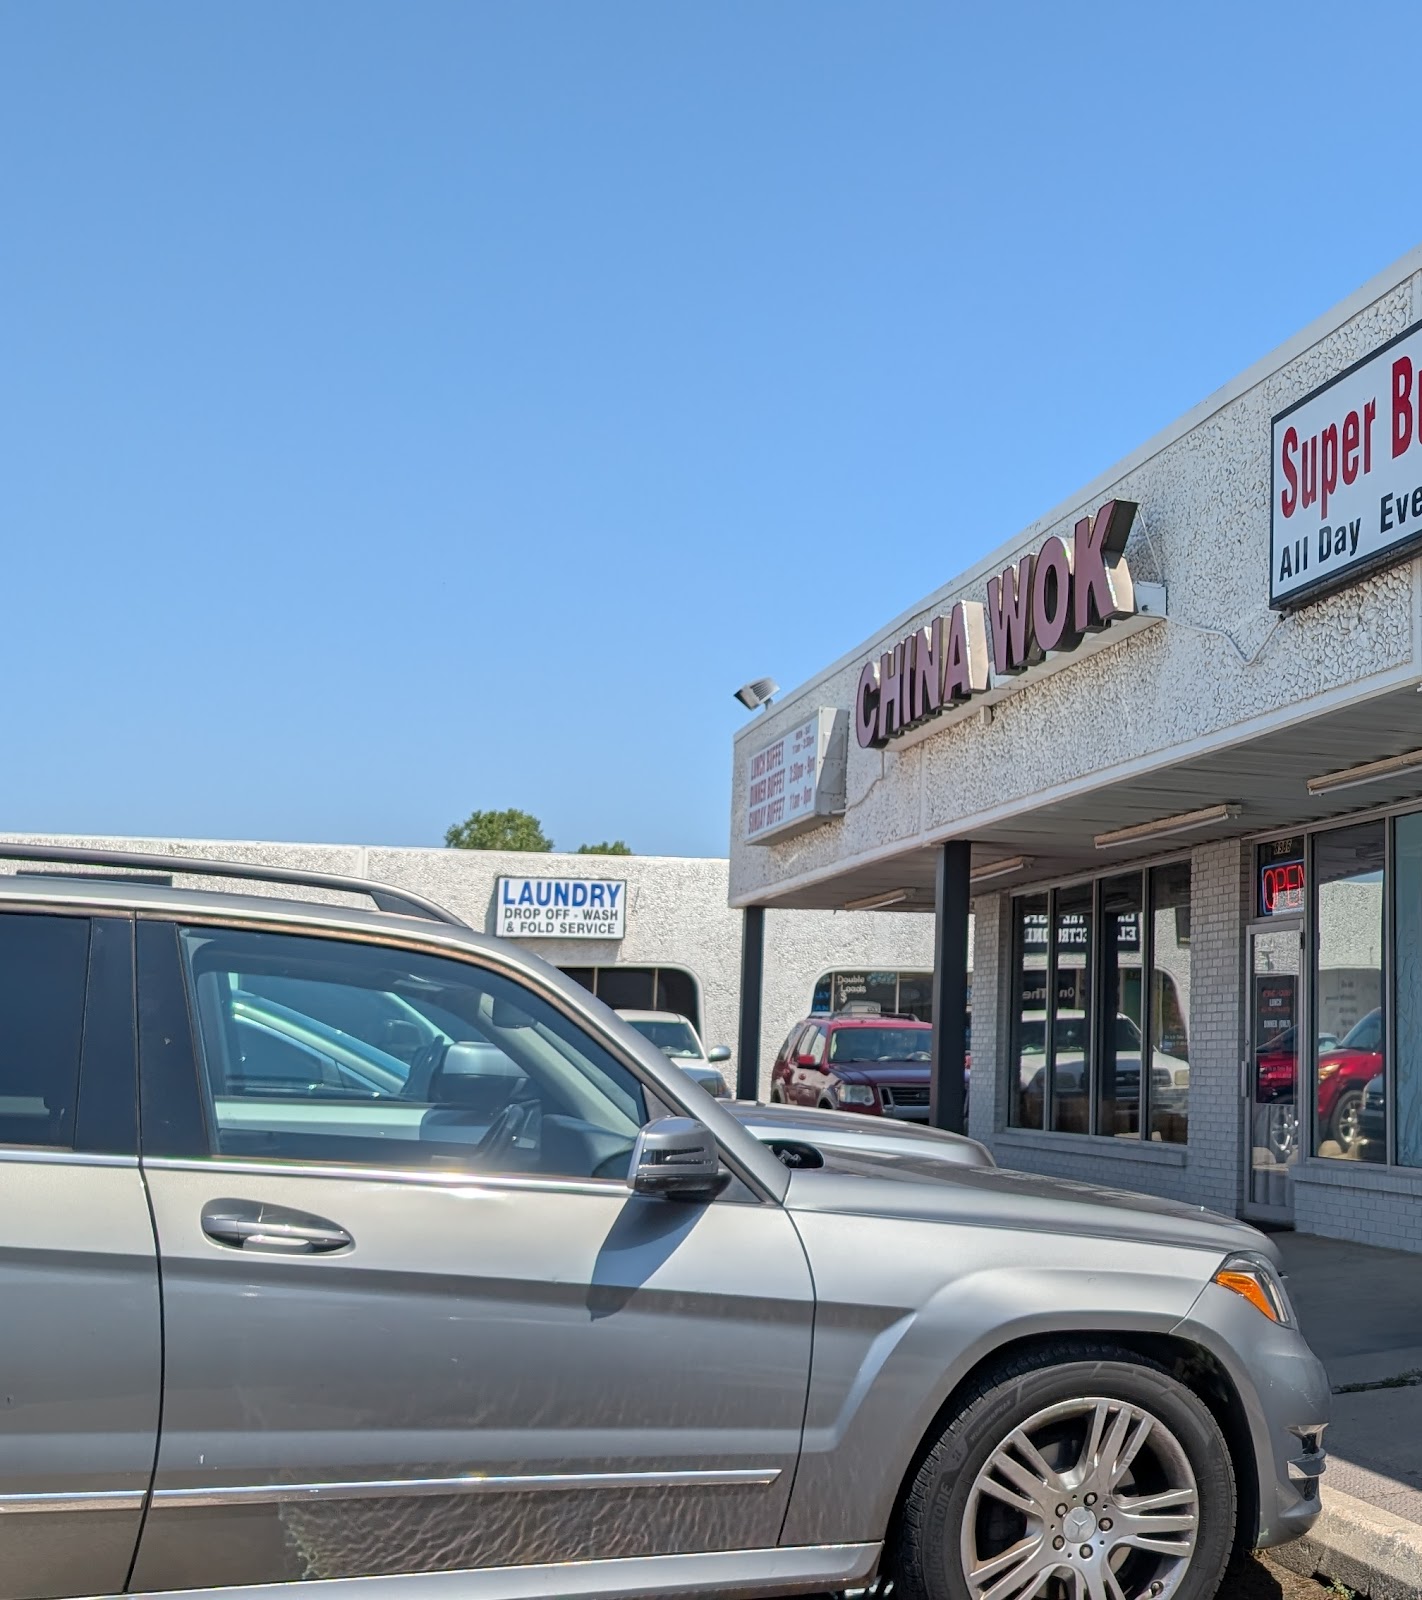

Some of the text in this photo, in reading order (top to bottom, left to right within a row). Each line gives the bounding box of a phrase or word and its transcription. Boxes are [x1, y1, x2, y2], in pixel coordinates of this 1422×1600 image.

[1281, 396, 1376, 520] Super
[1279, 536, 1308, 582] All
[1318, 518, 1361, 564] Day
[856, 498, 1122, 748] CHINA WOK
[751, 740, 784, 781] LUNCH BUFFET
[767, 768, 785, 800] BUFFET
[766, 796, 785, 826] BUFFET
[503, 880, 622, 908] LAUNDRY
[1264, 864, 1305, 910] OPEN
[504, 908, 541, 919] DROP
[545, 908, 570, 920] OFF
[582, 909, 618, 921] WASH
[506, 921, 616, 934] & FOLD SERVICE
[837, 974, 865, 985] Double
[840, 984, 867, 994] Loads
